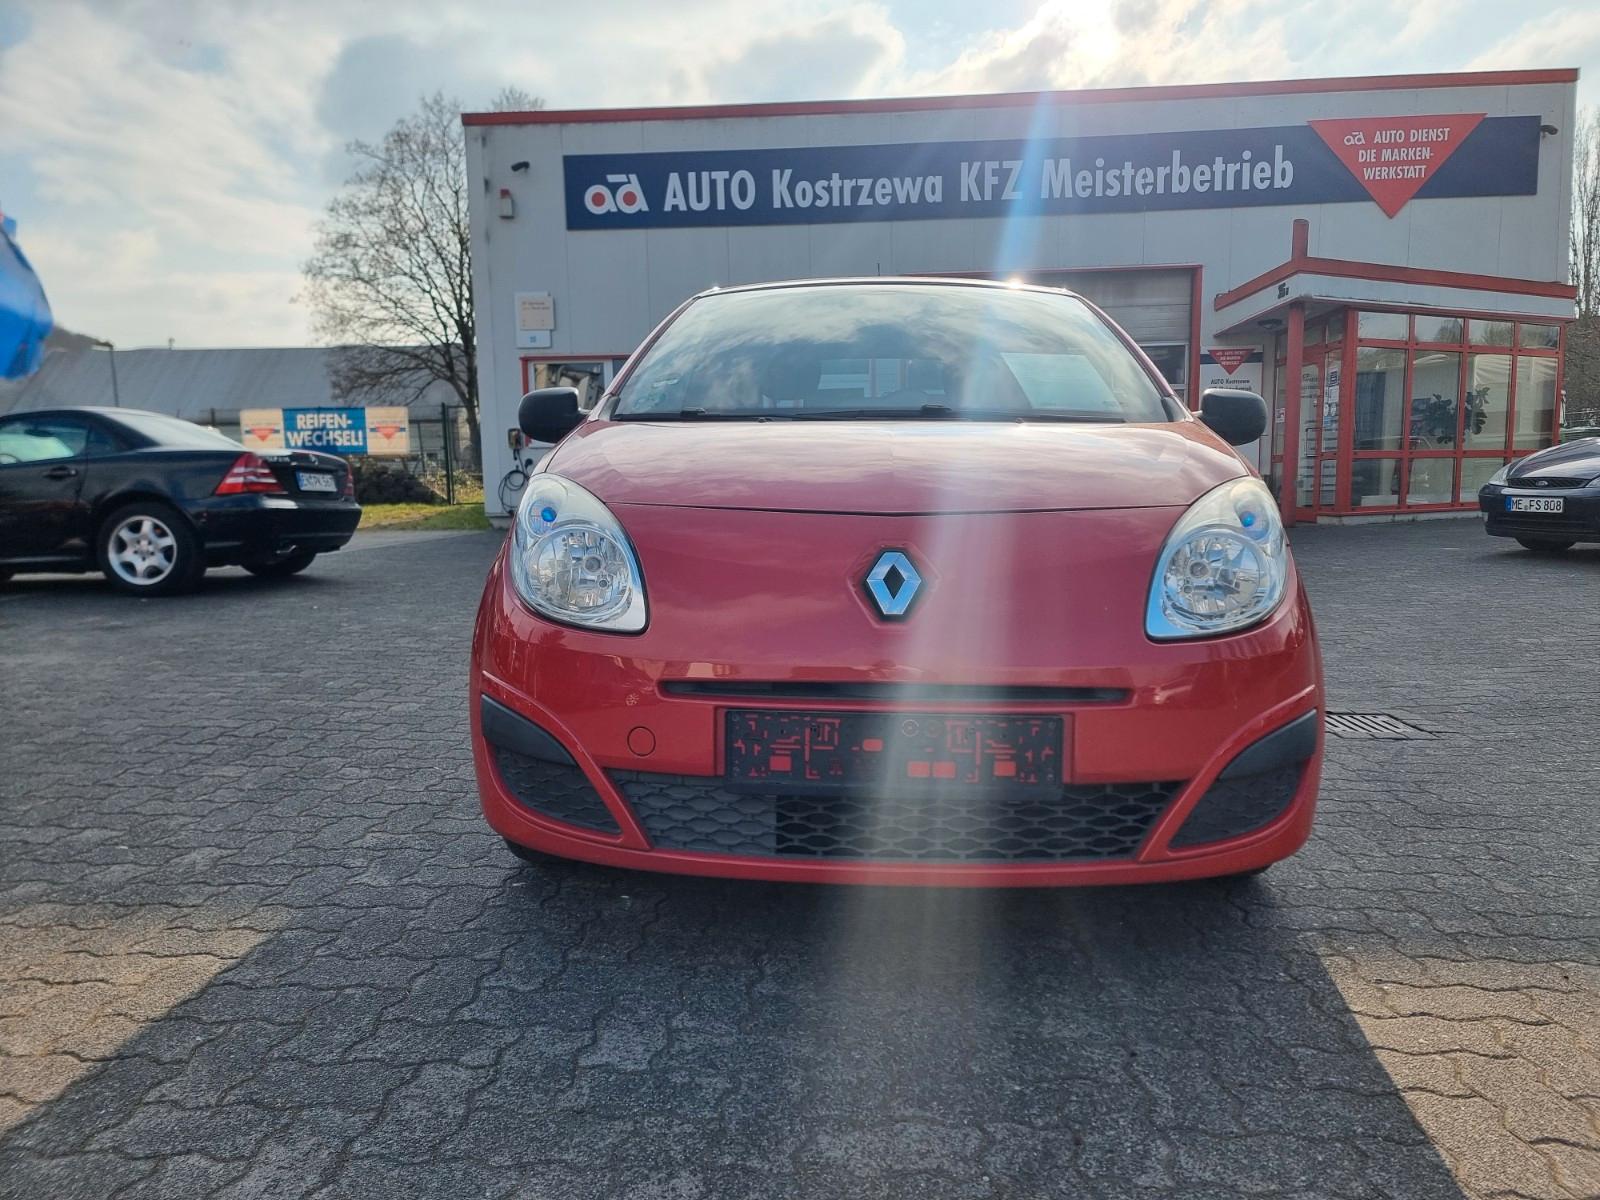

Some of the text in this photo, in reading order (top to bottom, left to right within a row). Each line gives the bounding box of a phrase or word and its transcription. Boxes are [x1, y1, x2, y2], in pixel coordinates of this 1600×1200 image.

[1374, 129, 1405, 144] AUTO
[1409, 127, 1450, 142] DIENST
[1358, 147, 1434, 163] DIE MARKEN-
[664, 169, 756, 212] AUTO
[772, 168, 942, 209] Kostrzewa
[960, 160, 1024, 202] KFZ
[1040, 144, 1294, 200] Meisterbetrieb
[1363, 165, 1427, 180] WERKSTATT
[296, 413, 352, 429] REIFEN-
[287, 430, 363, 447] WECHSEL!
[1511, 499, 1562, 511] ME FS 808
